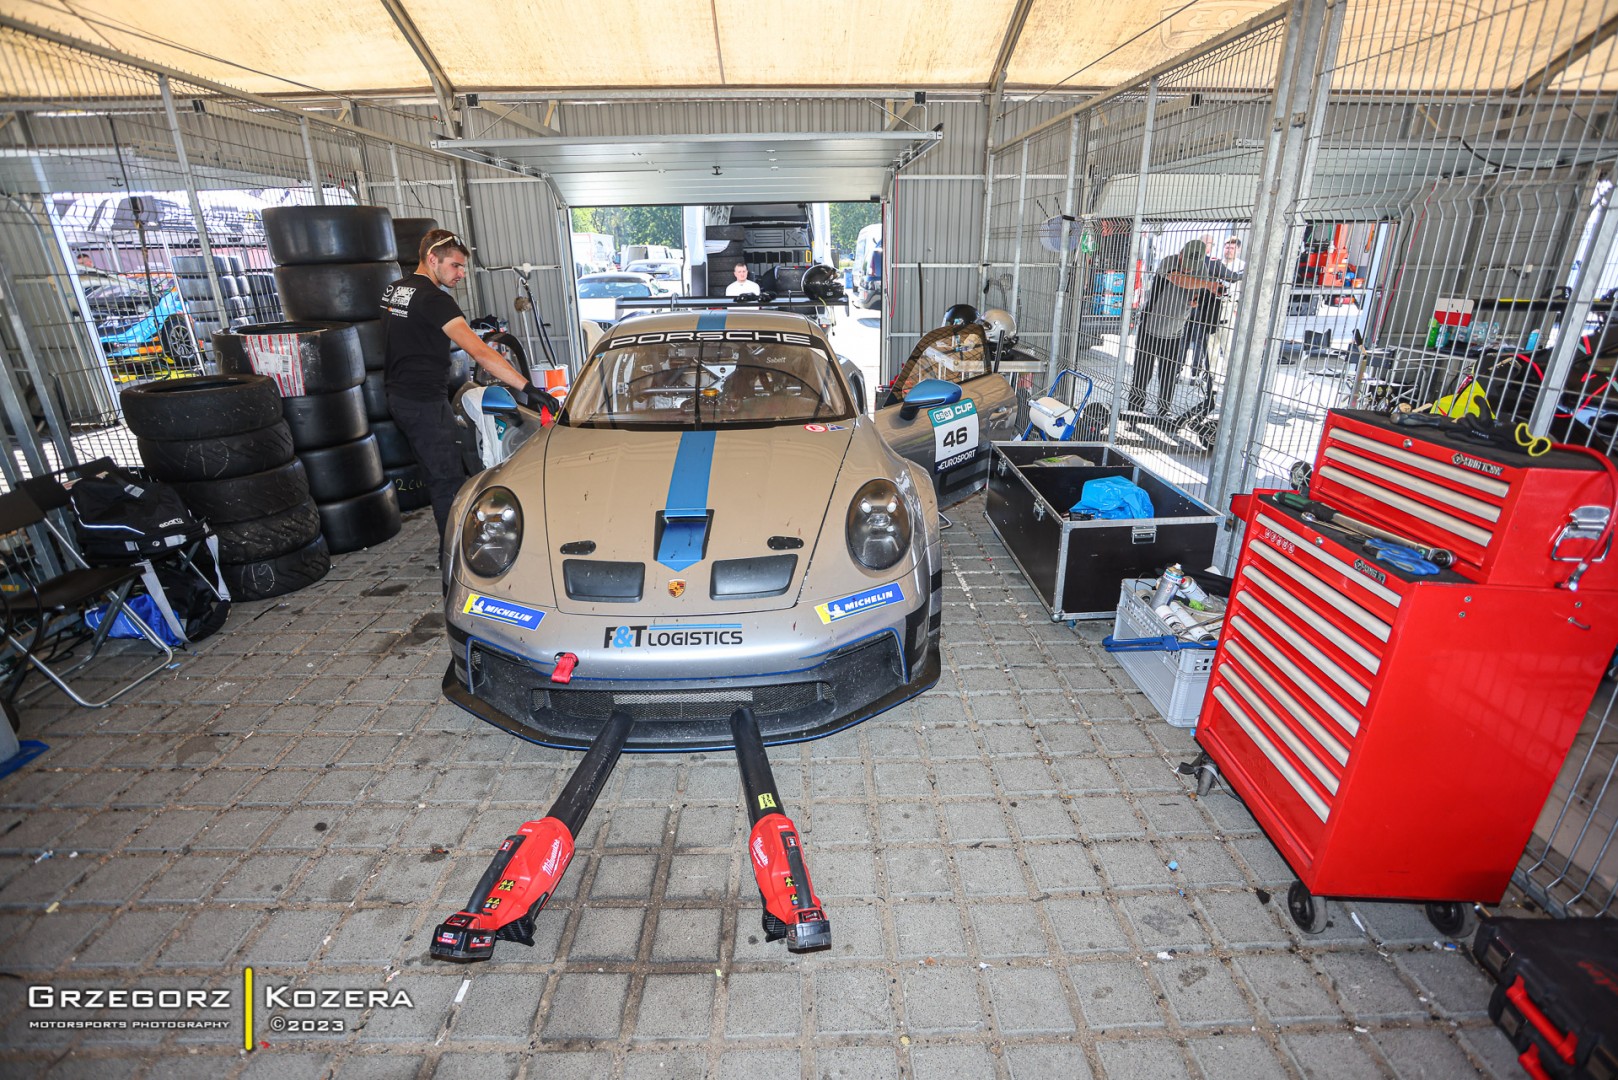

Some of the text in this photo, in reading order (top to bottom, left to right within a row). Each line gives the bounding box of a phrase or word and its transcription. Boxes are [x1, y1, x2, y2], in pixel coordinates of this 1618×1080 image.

[608, 331, 811, 349] PORSCHE
[954, 402, 973, 415] CUP
[942, 426, 968, 447] 46
[937, 449, 976, 471] EUROSPORT
[395, 478, 407, 491] 2
[844, 590, 893, 611] MICHELIN
[484, 605, 533, 622] MICHELIN
[603, 625, 743, 648] F&T LOGISTICS
